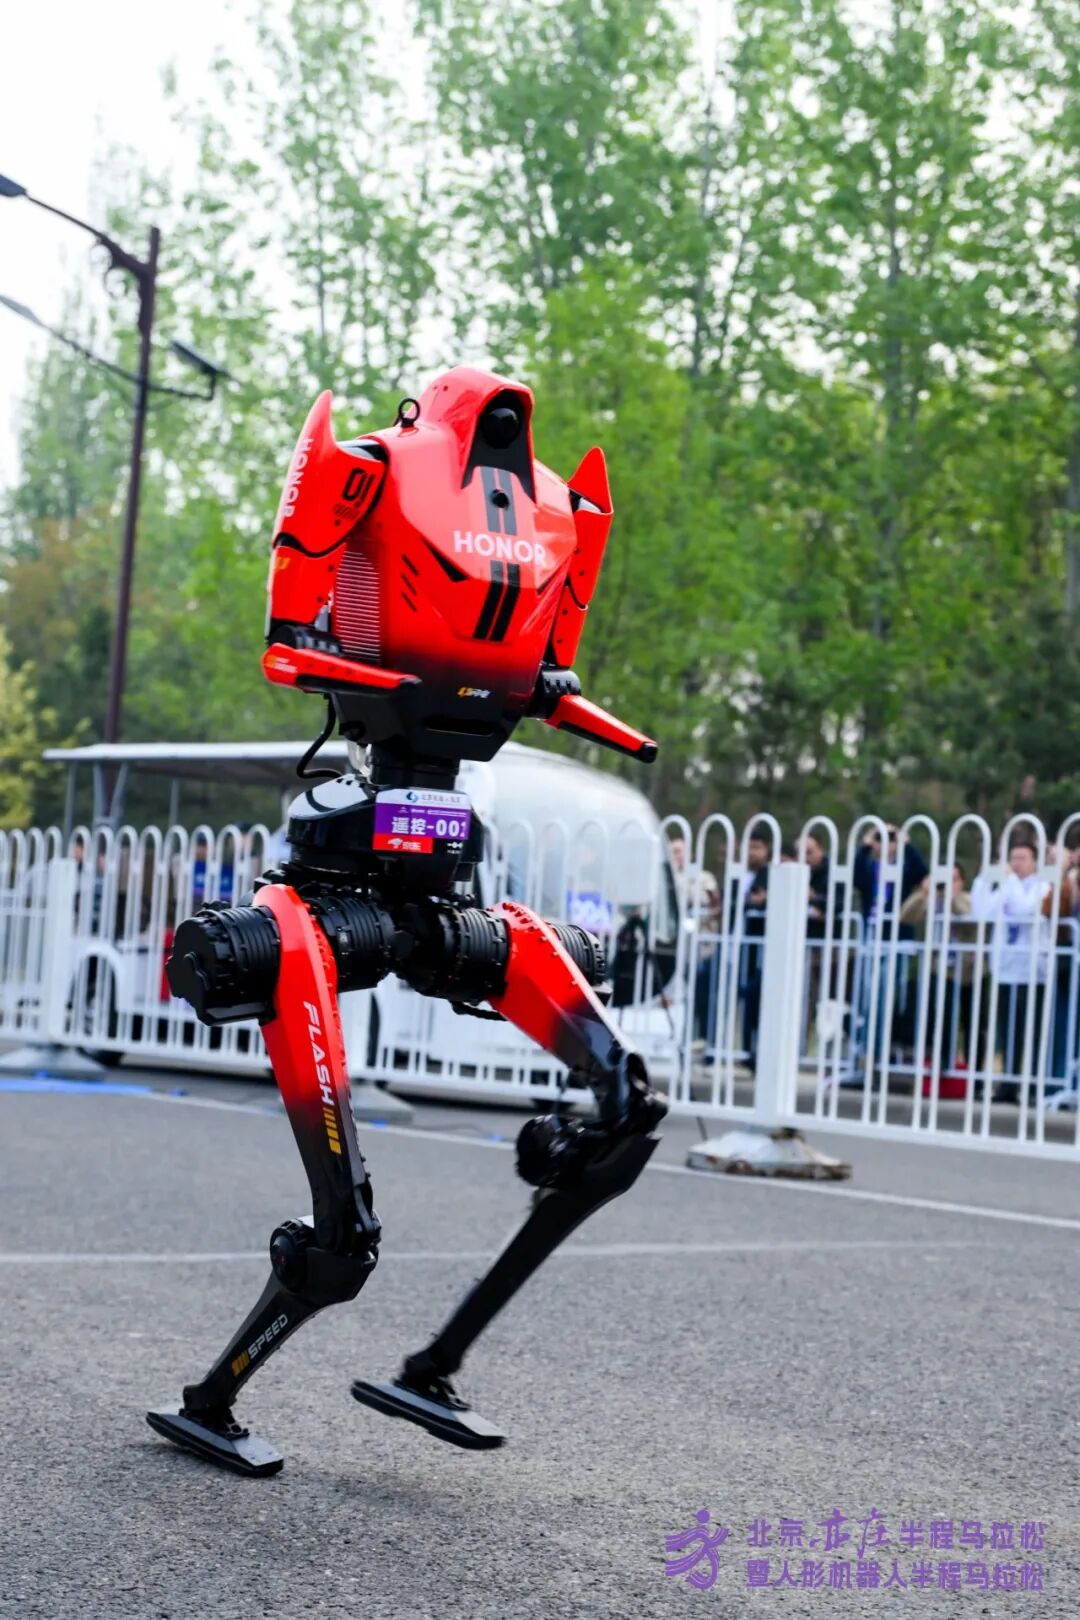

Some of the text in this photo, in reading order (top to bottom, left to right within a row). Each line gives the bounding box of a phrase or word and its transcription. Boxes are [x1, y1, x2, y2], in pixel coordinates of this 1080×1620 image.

[453, 530, 547, 568] HONOR
[303, 1000, 335, 1106] FLASH
[248, 1313, 288, 1359] SPEED
